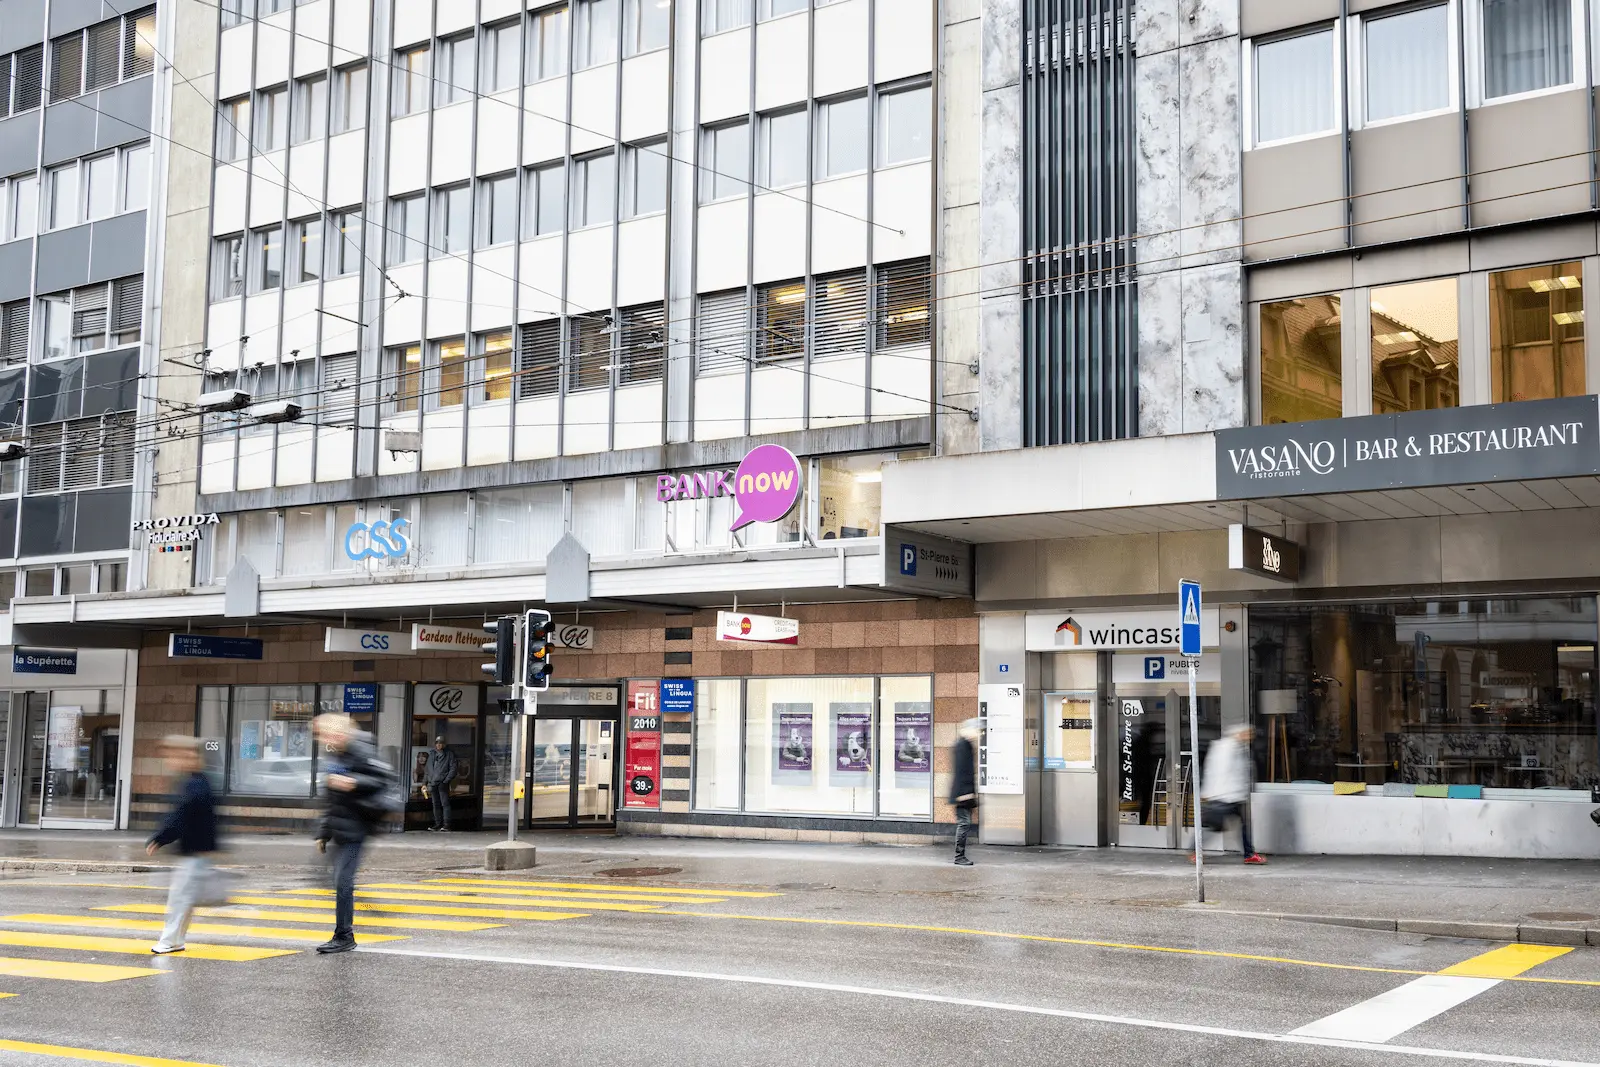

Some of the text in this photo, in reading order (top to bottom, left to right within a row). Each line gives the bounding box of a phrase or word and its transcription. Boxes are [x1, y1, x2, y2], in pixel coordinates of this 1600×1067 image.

[1356, 422, 1583, 461] BAR & RESTAURANT
[1228, 439, 1335, 475] VASANO
[739, 470, 794, 494] now
[1250, 470, 1301, 479] ristorante
[656, 470, 735, 501] BANK
[132, 512, 221, 531] PROVIDA
[149, 528, 202, 544] Fiduciaire SA
[345, 517, 409, 560] CSS
[904, 548, 914, 571] P
[920, 549, 949, 564] St-Pierre
[726, 620, 741, 628] BANK
[361, 634, 389, 649] CSS
[419, 628, 453, 643] Cardoso
[15, 655, 75, 667] la Supérette.
[1149, 659, 1161, 677] P
[1169, 660, 1200, 668] PUBLC
[606, 692, 613, 700] 8
[1007, 688, 1019, 697] 6b
[634, 692, 656, 710] Fit
[1123, 702, 1140, 716] 6b
[634, 718, 656, 729] 2010
[205, 741, 219, 751] CSS
[1122, 720, 1133, 801] Rue St-Pierre
[635, 780, 652, 791] 39.-
